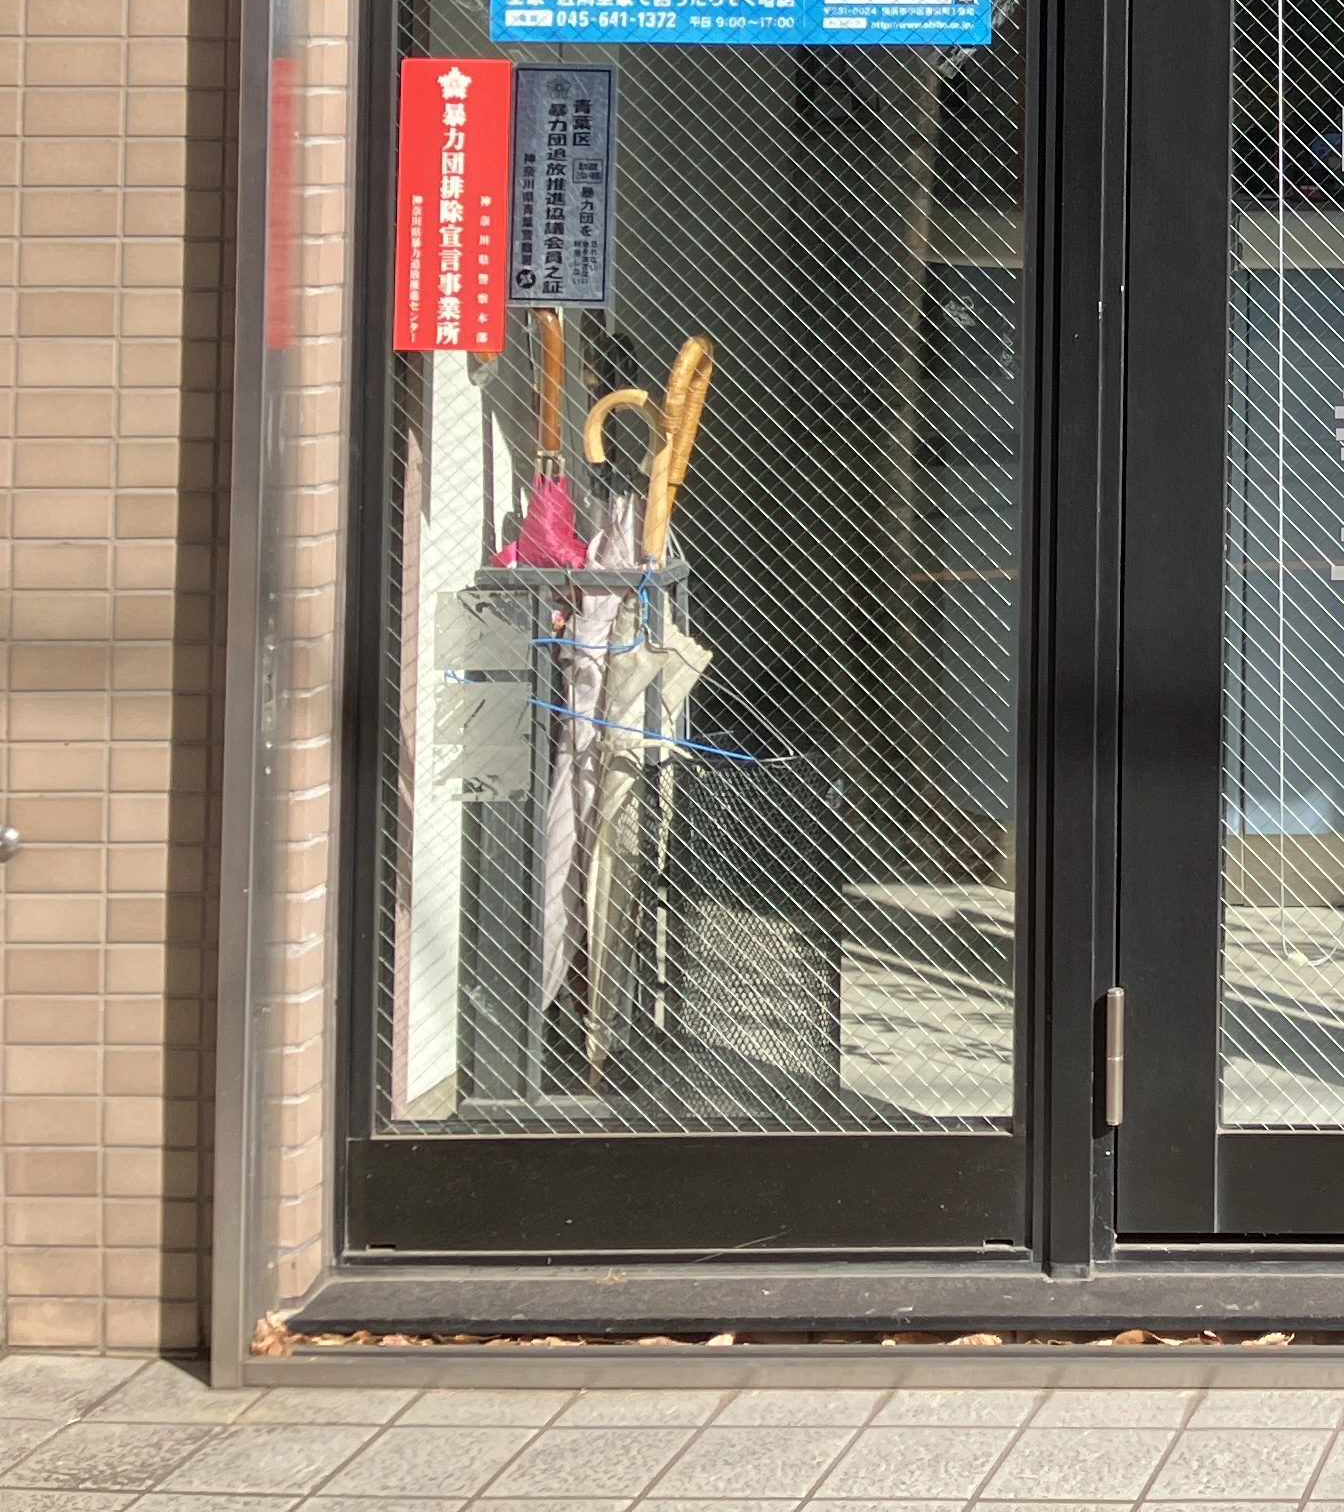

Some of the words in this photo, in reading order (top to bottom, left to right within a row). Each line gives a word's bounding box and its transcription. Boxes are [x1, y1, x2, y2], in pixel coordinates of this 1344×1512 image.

[556, 10, 677, 28] 045-641-1372
[689, 16, 711, 28] 平日
[435, 103, 468, 345] 暴力団排除宣言事業所
